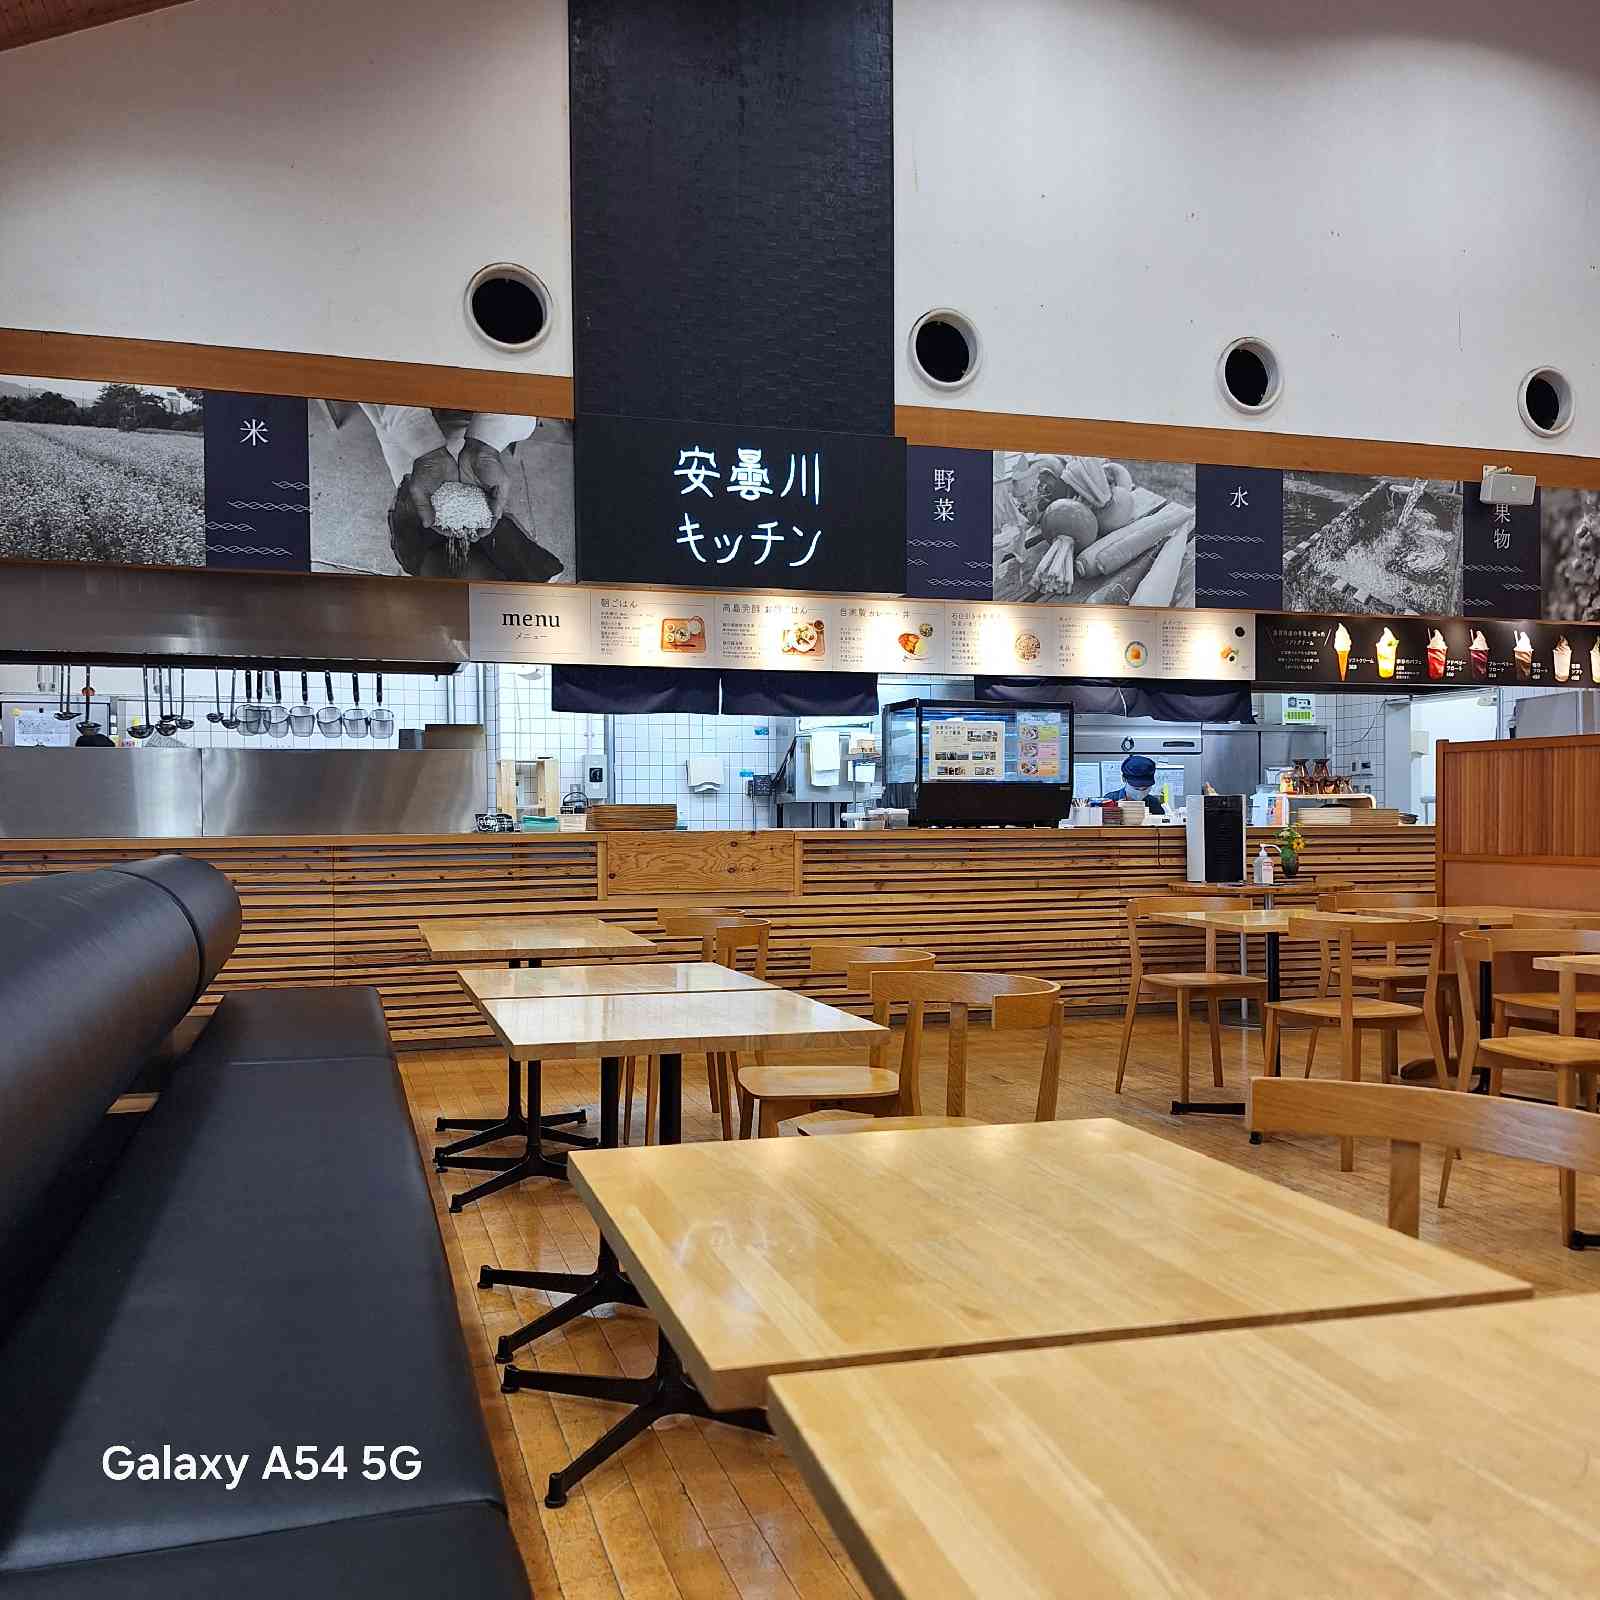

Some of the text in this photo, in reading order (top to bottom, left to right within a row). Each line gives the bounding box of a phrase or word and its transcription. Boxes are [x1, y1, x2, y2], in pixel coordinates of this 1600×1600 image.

[239, 418, 269, 447] 米
[673, 445, 821, 505] 安曇川
[933, 468, 955, 521] 野菜
[1229, 485, 1249, 508] 水
[676, 512, 822, 567] キッチン
[1493, 503, 1512, 550] 果物
[501, 612, 561, 628] menu
